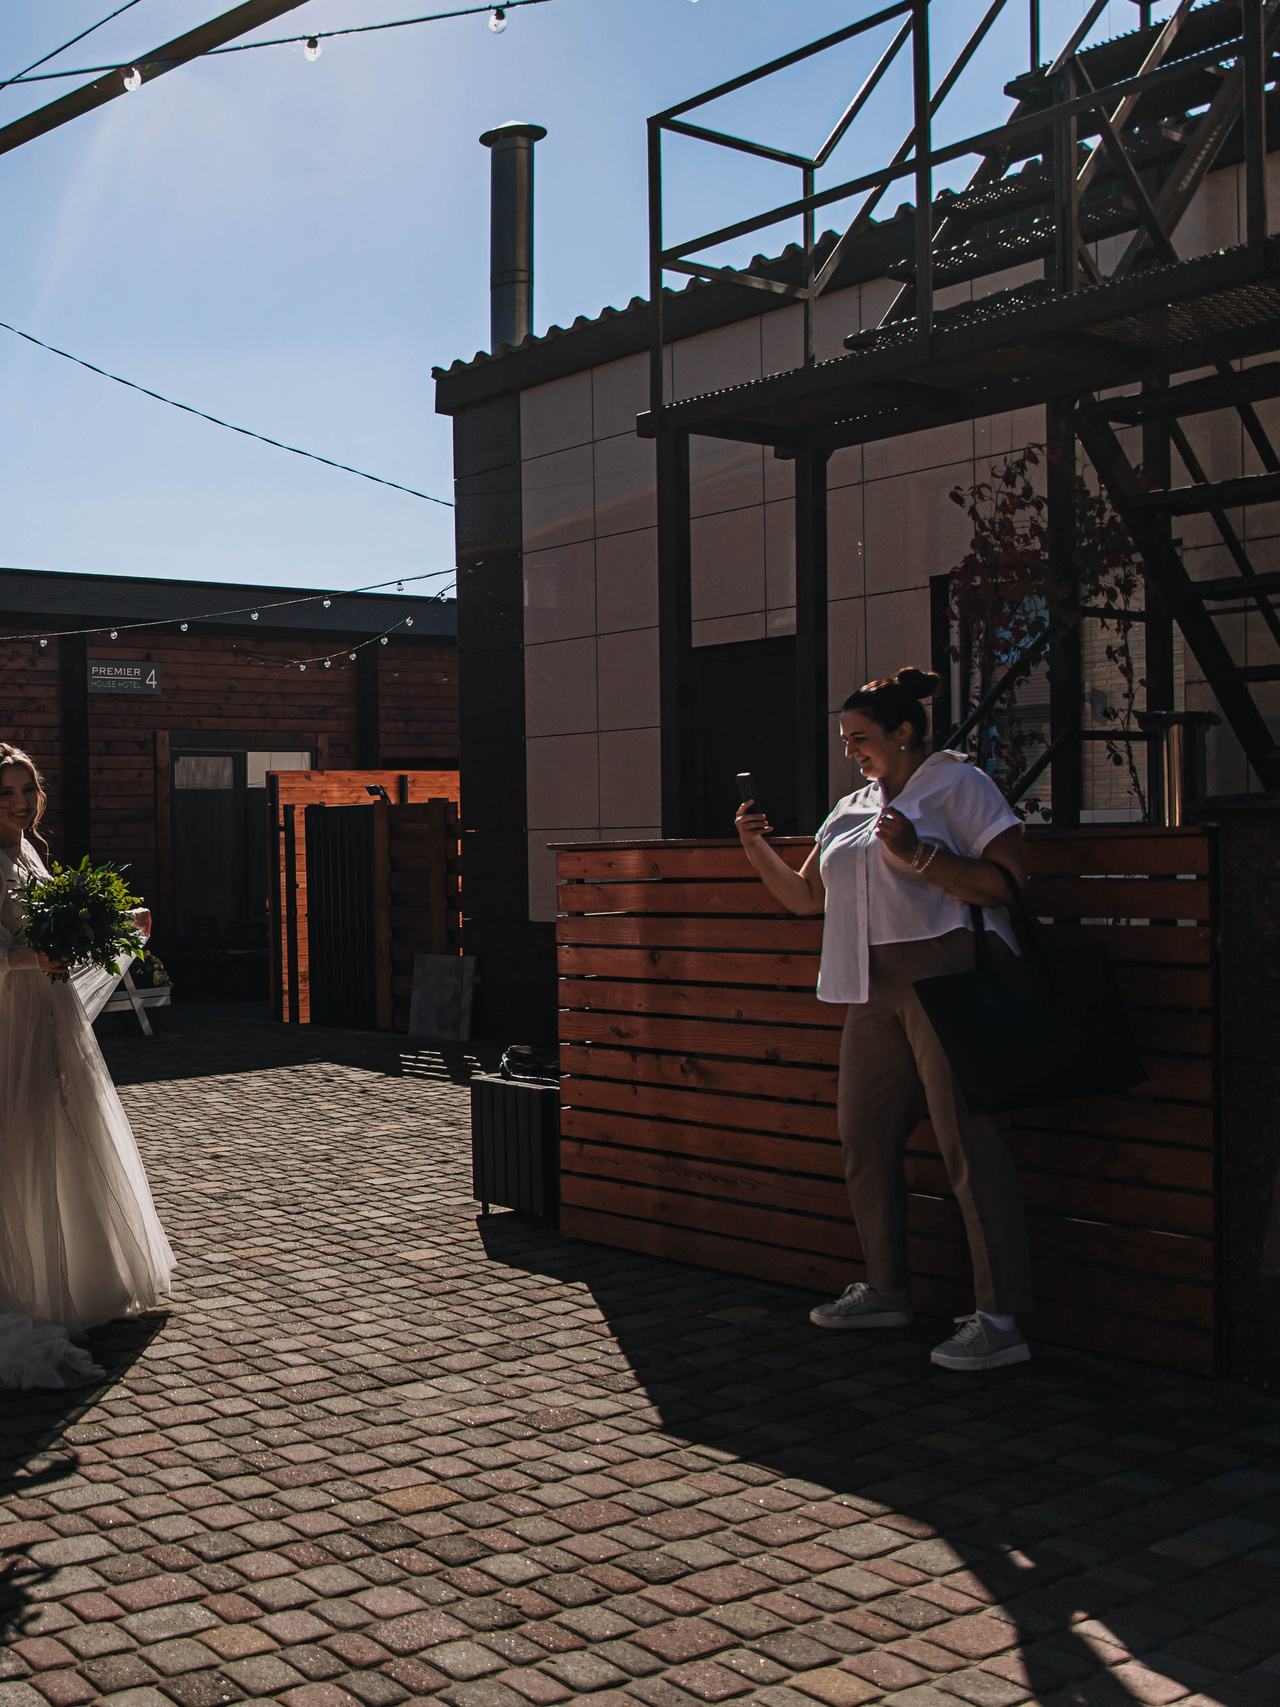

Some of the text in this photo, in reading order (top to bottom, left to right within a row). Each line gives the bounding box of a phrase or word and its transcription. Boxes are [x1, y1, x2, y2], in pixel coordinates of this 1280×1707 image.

[91, 667, 141, 676] PREMIER
[146, 669, 157, 689] 4
[91, 680, 141, 689] HOUSE HOTEL
